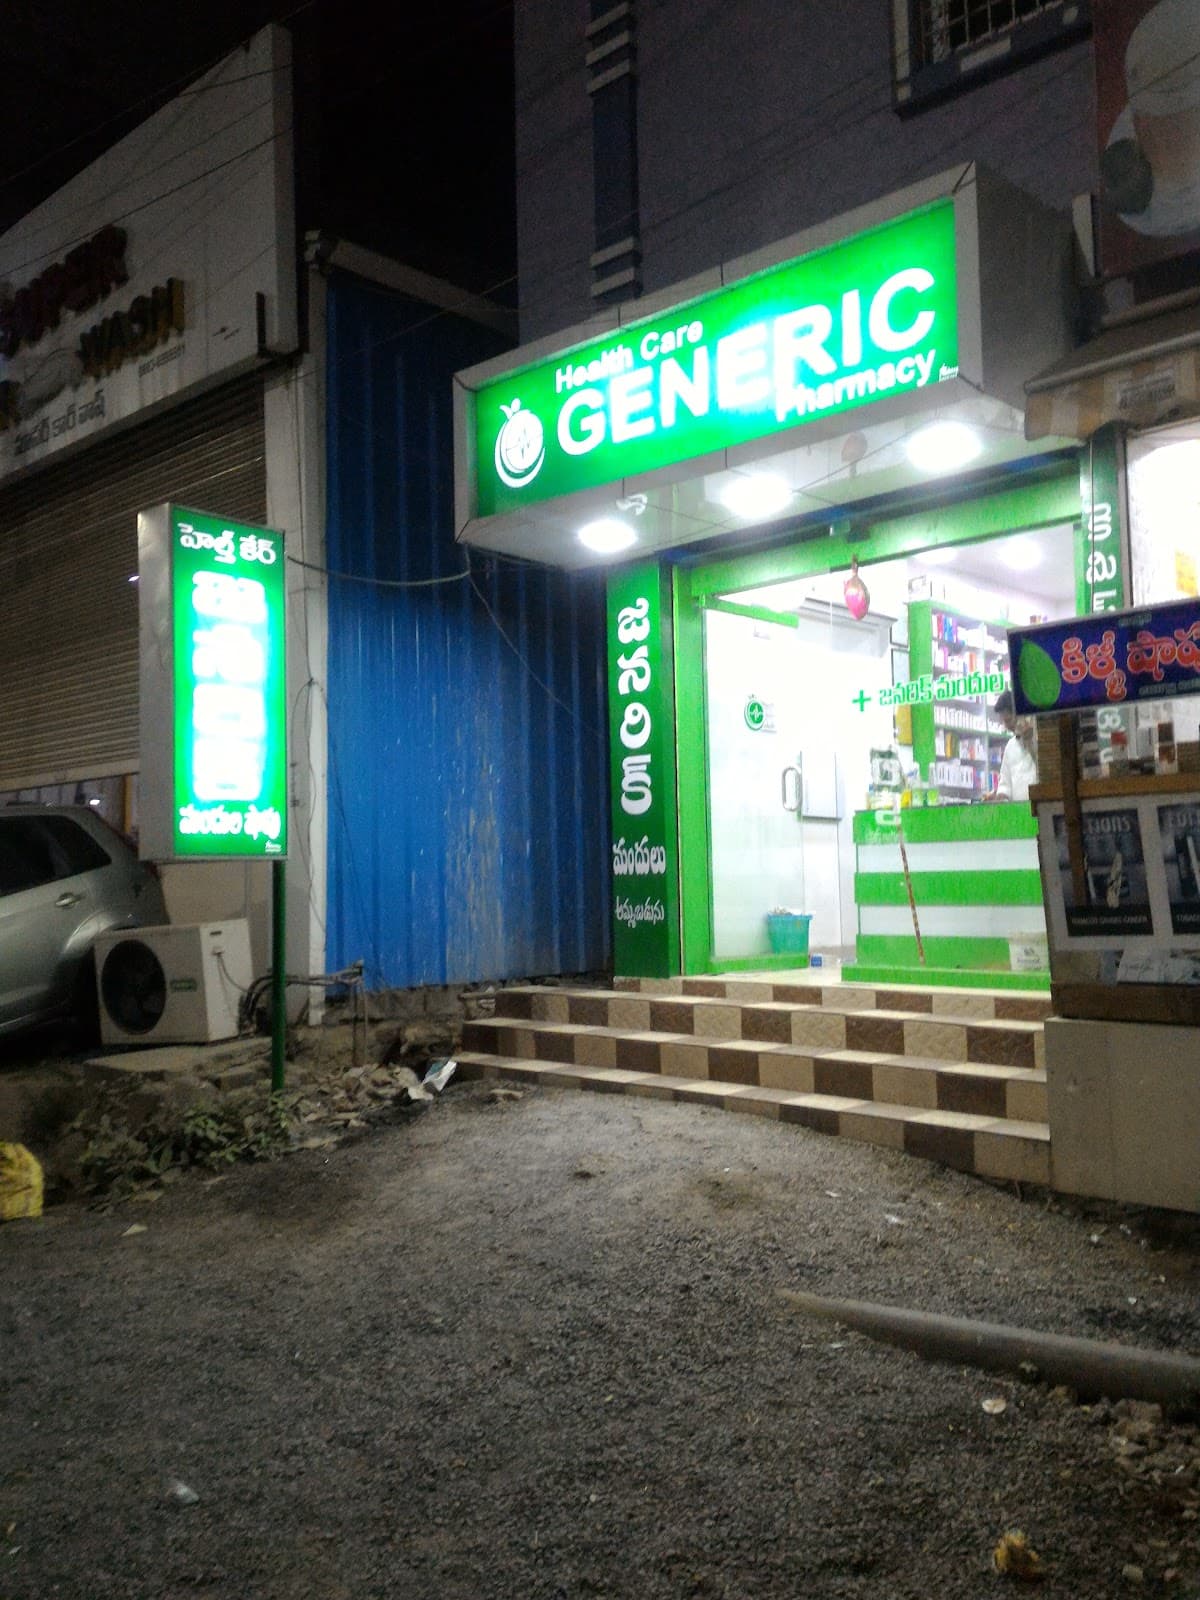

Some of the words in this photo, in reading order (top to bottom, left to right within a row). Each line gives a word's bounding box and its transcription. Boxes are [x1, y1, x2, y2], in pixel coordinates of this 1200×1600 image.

[555, 344, 633, 394] Health
[640, 319, 704, 363] Care
[556, 267, 936, 456] GENERIC
[775, 348, 937, 422] Pharmacy
[612, 835, 666, 876] మందులు
